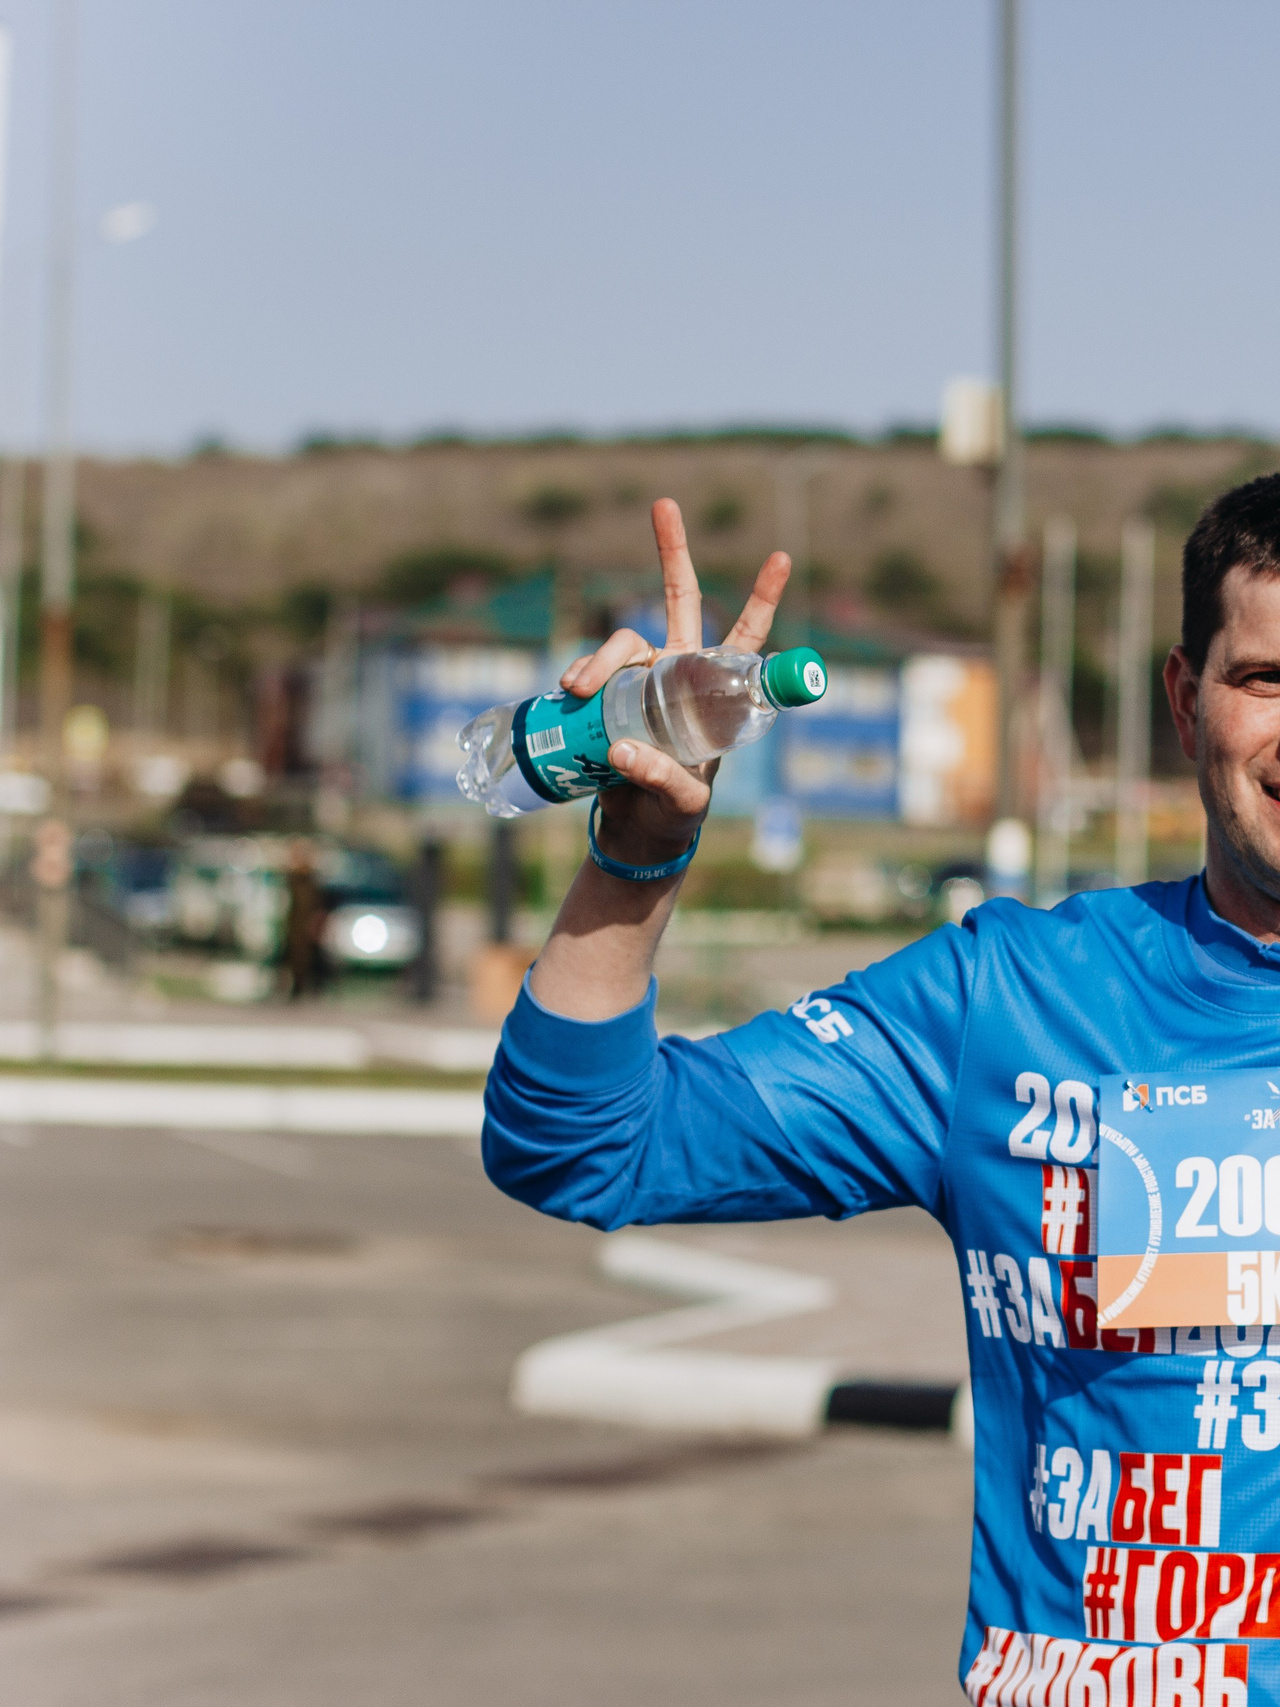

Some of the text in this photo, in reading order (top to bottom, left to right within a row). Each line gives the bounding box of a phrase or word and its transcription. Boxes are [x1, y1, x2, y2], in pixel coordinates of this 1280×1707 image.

[1009, 1071, 1099, 1164] 20
[1156, 1084, 1208, 1107] ПСБ
[1030, 1443, 1222, 1547] #ЗАБЕГ
